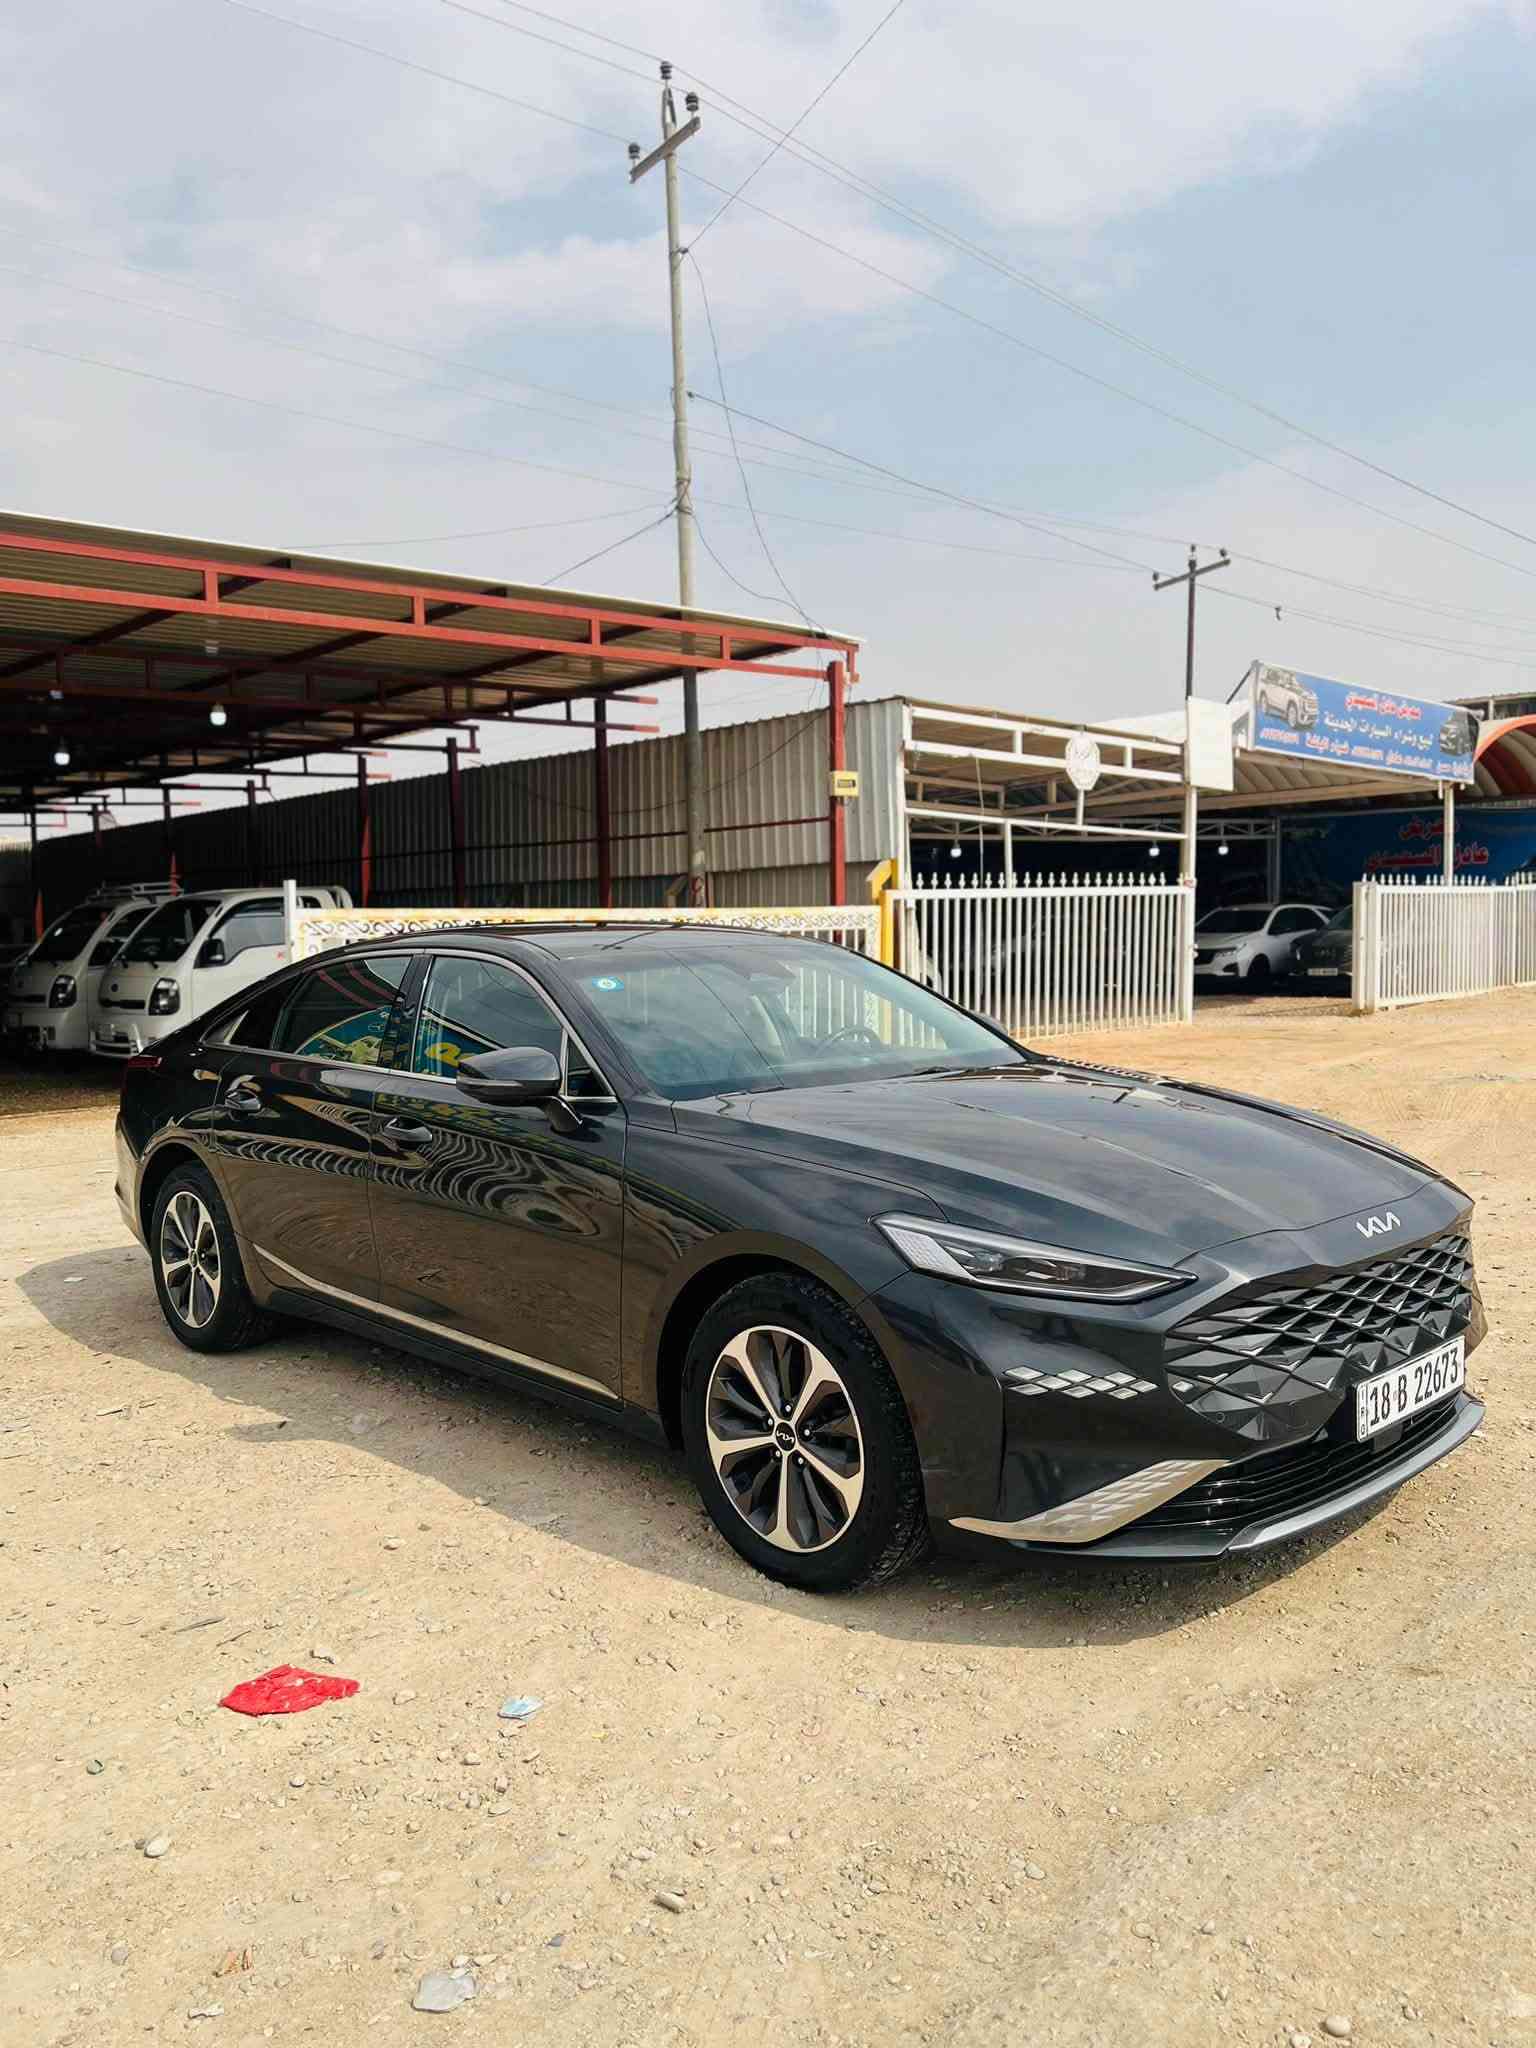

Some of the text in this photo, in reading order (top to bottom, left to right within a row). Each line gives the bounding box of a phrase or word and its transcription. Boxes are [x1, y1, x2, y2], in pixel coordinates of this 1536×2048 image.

[1359, 719, 1392, 738] السيارات
[1356, 1211, 1400, 1238] KIA
[1370, 1349, 1459, 1426] 18 B 22673
